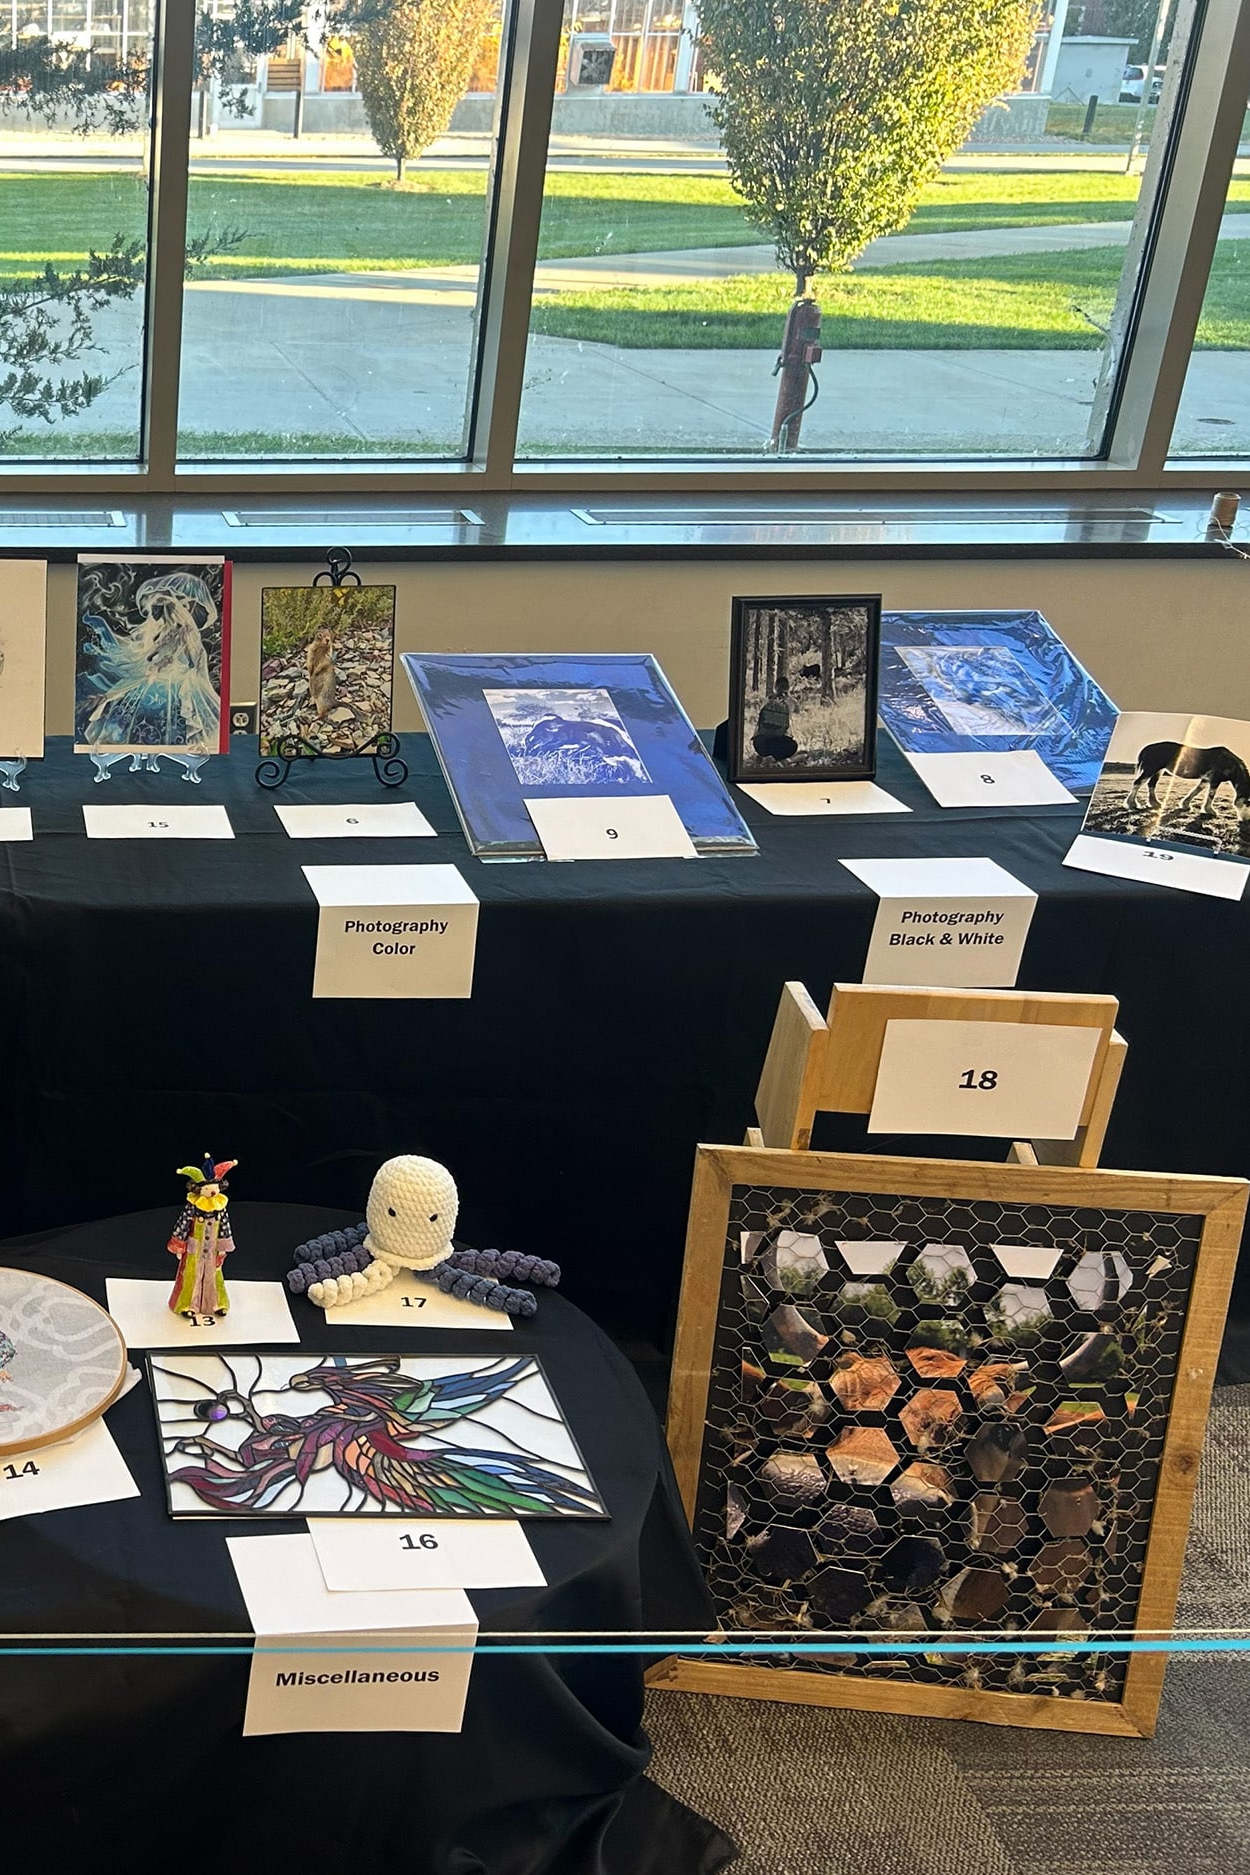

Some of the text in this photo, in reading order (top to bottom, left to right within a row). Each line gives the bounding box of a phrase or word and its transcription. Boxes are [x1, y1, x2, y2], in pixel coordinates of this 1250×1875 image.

[980, 774, 996, 784] 8
[150, 821, 169, 829] 15
[605, 828, 619, 840] 9
[1142, 850, 1175, 861] 19
[901, 909, 1005, 926] Photography
[344, 918, 449, 935] Photography
[888, 932, 1005, 946] Black & White
[372, 942, 416, 955] Color
[958, 1069, 998, 1090] 18
[400, 1296, 427, 1308] 17
[189, 1315, 216, 1327] 13
[3, 1460, 40, 1480] 14
[399, 1533, 439, 1550] 16
[274, 1669, 440, 1687] Miscellaneous
